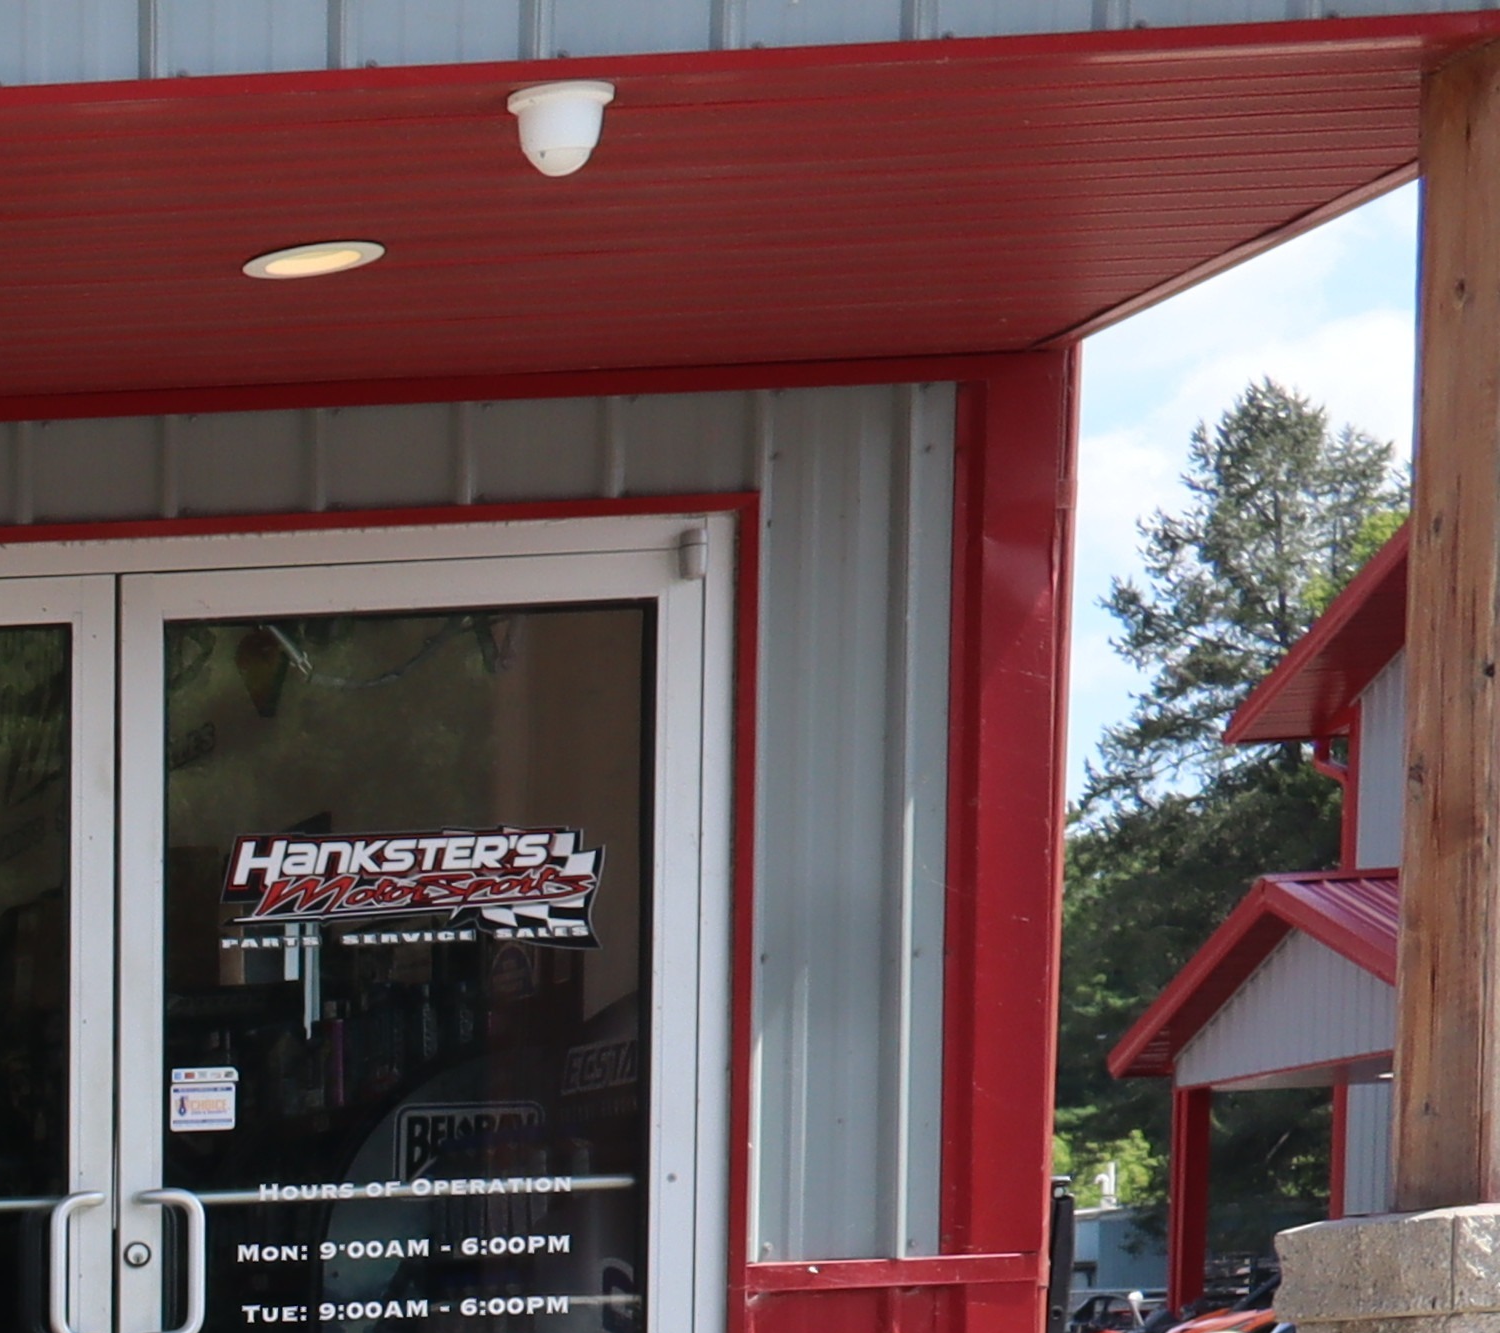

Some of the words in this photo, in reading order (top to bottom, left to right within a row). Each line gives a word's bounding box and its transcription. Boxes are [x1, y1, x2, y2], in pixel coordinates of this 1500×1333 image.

[221, 936, 322, 950] PARTS
[340, 929, 476, 946] SERVICE
[492, 924, 591, 940] SALES
[461, 1234, 571, 1255] 6:00PM
[318, 1299, 429, 1320] 9:00AM
[459, 1295, 570, 1316] 6:00PM
